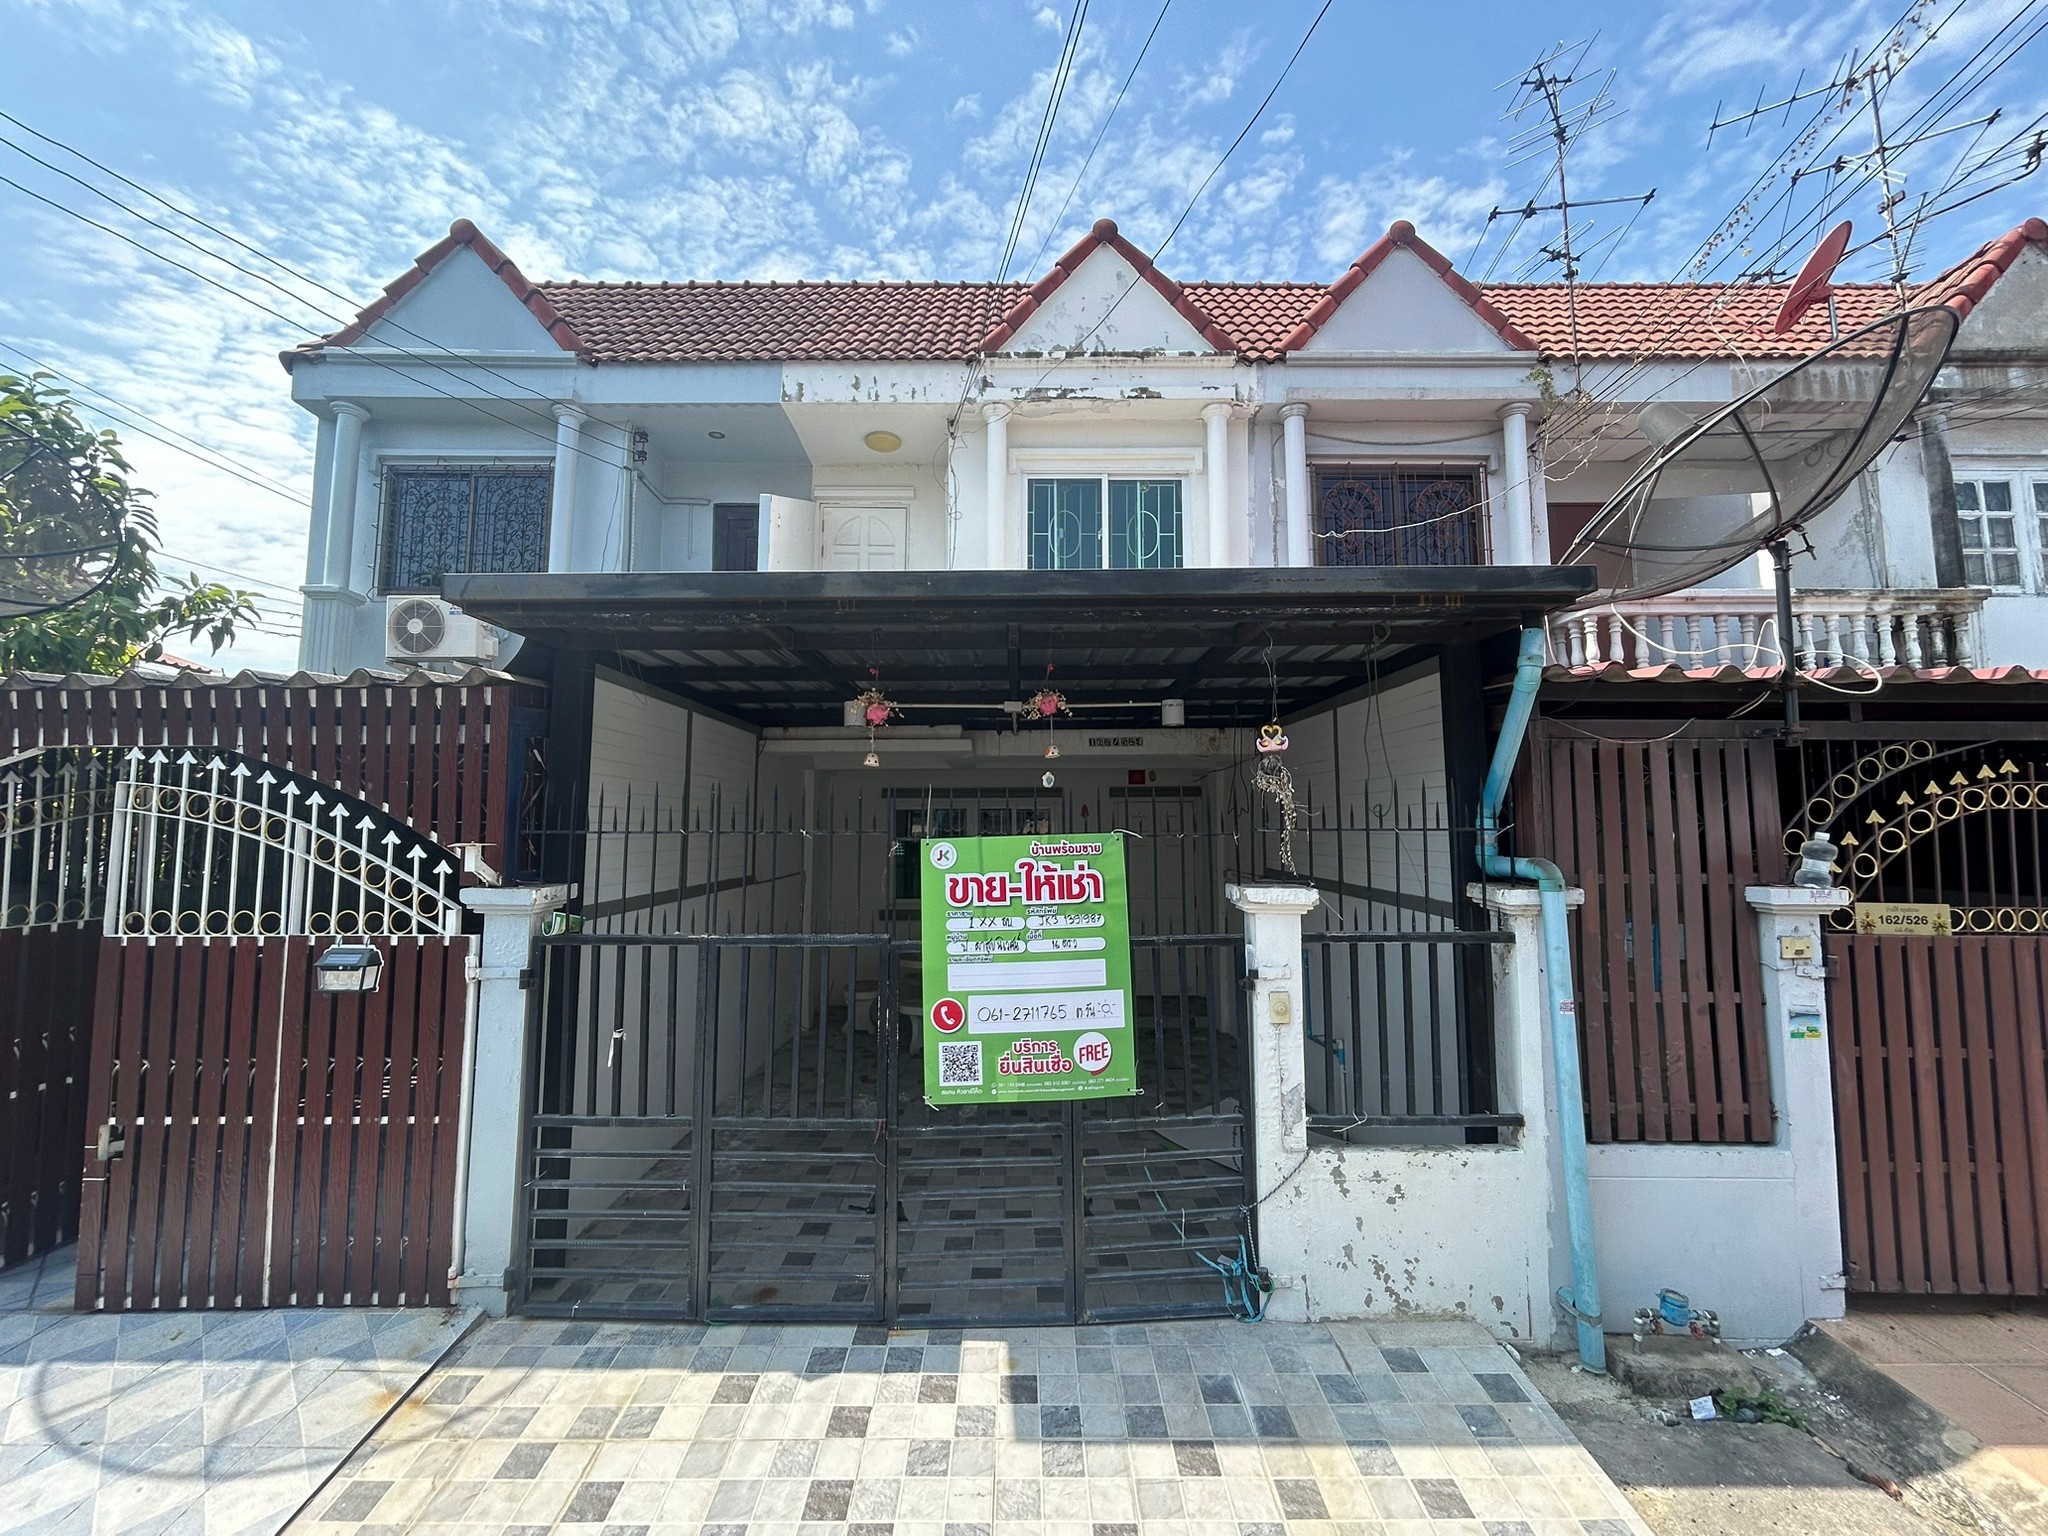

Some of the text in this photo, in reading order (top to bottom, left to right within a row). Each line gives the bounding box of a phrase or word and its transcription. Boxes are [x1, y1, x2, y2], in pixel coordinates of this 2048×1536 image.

[1031, 840, 1101, 855] บ้านพร้อมขาย
[949, 861, 1103, 905] ขาย-ให้เช่า
[1878, 915, 1929, 925] 162/526
[977, 1004, 1067, 1022] 061-2711765
[1013, 1039, 1058, 1054] บริการ
[1078, 1041, 1109, 1064] FREE
[999, 1051, 1073, 1075] ยื่นสินเชื่อ
